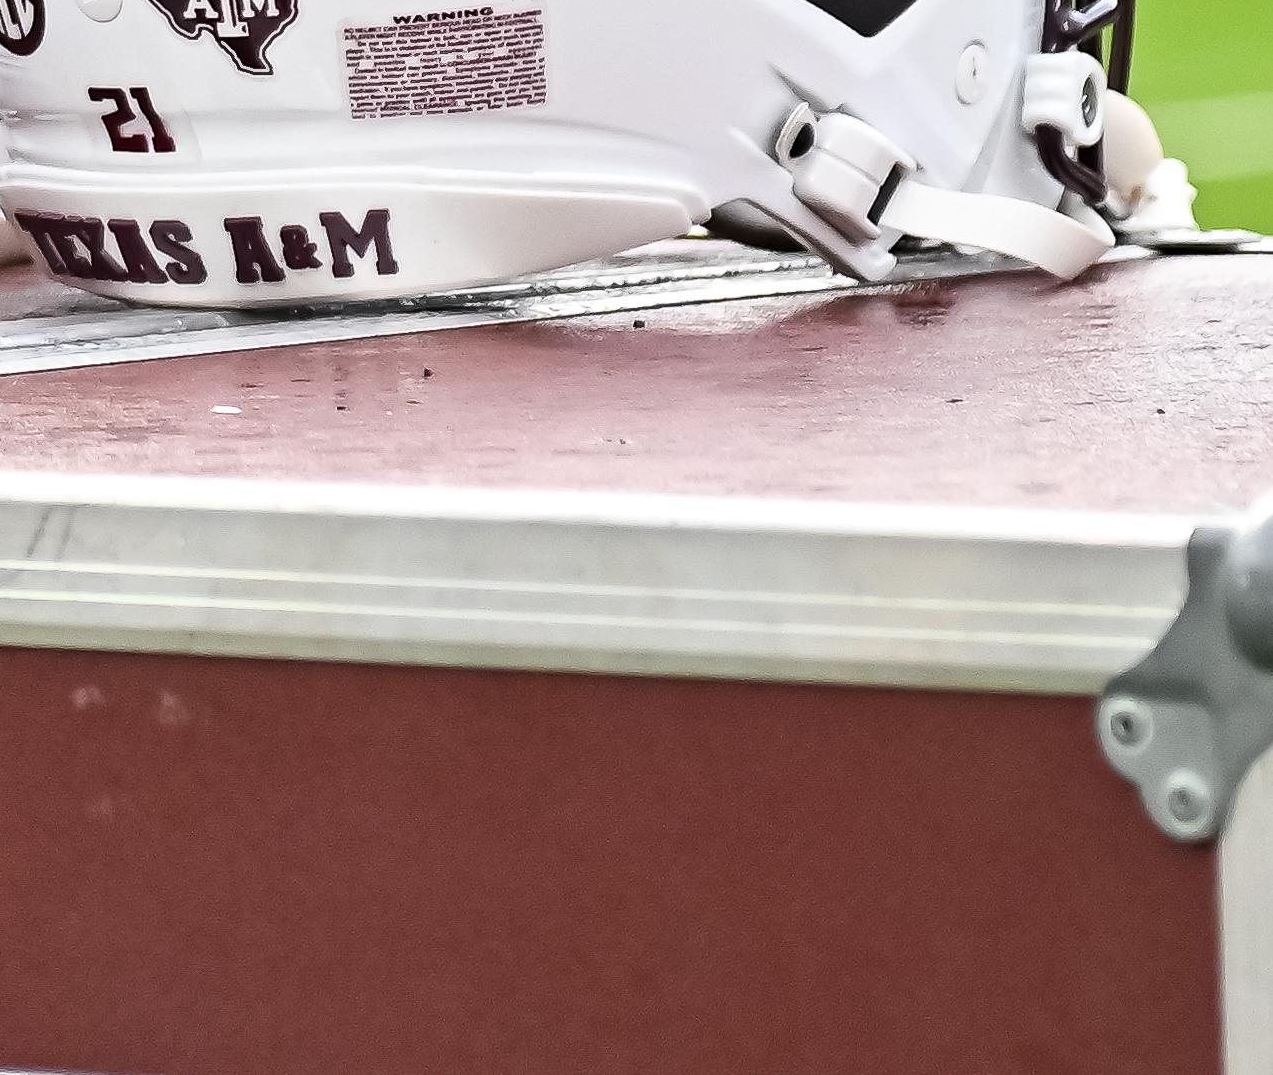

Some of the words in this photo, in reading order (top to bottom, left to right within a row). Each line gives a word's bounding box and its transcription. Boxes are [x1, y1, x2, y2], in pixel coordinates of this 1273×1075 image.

[393, 6, 495, 25] WARNING
[87, 86, 176, 153] 21
[14, 208, 209, 285] TEXAS
[222, 208, 399, 285] A&M
